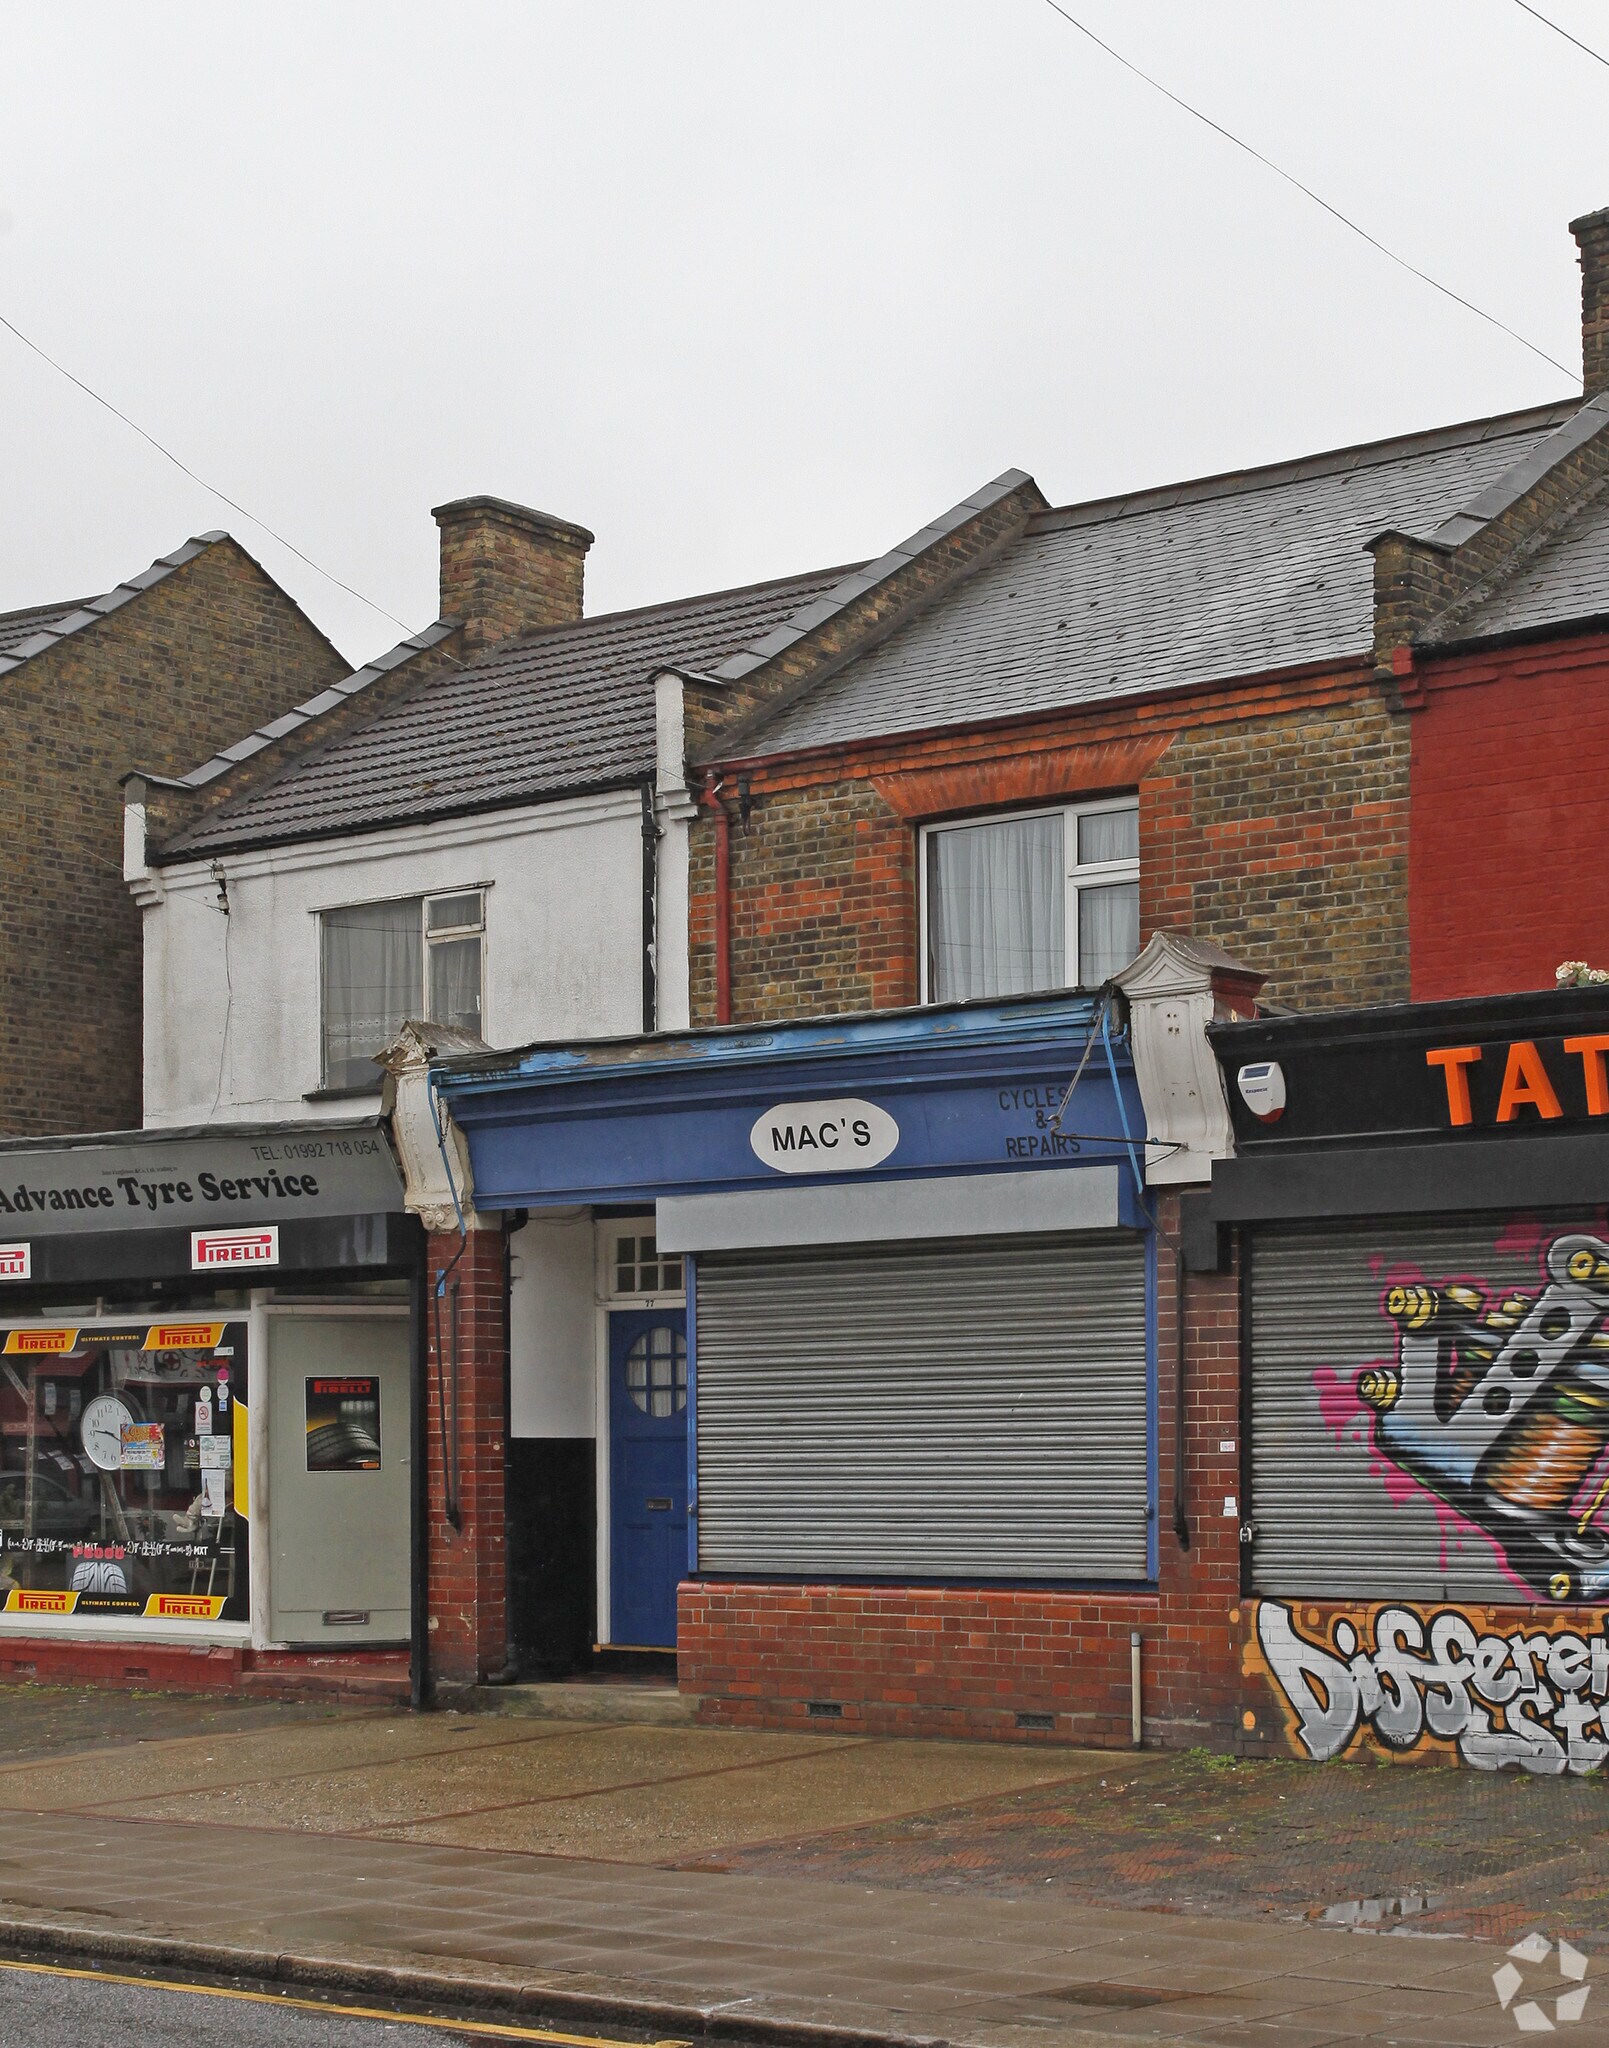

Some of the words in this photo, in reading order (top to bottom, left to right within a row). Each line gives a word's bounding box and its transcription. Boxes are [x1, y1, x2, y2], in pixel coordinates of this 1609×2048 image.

[999, 1086, 1070, 1111] CYCLES
[1036, 1109, 1048, 1129] &
[771, 1118, 871, 1151] MAC'S
[1006, 1133, 1081, 1157] REPAIRS
[251, 1146, 282, 1160] TEL:
[284, 1143, 326, 1159] 01992
[327, 1141, 352, 1156] 718
[354, 1140, 380, 1155] 054
[117, 1177, 194, 1211] Tyre
[198, 1168, 319, 1202] Service
[197, 1234, 272, 1263] PIRELLI
[18, 1333, 66, 1349] PIRELLI
[159, 1327, 212, 1345] PIRELLI
[314, 1380, 371, 1393] PIRELLI
[193, 1545, 209, 1556] MXT
[18, 1593, 66, 1610] PIRELLI
[159, 1597, 212, 1616] PIRELLI
